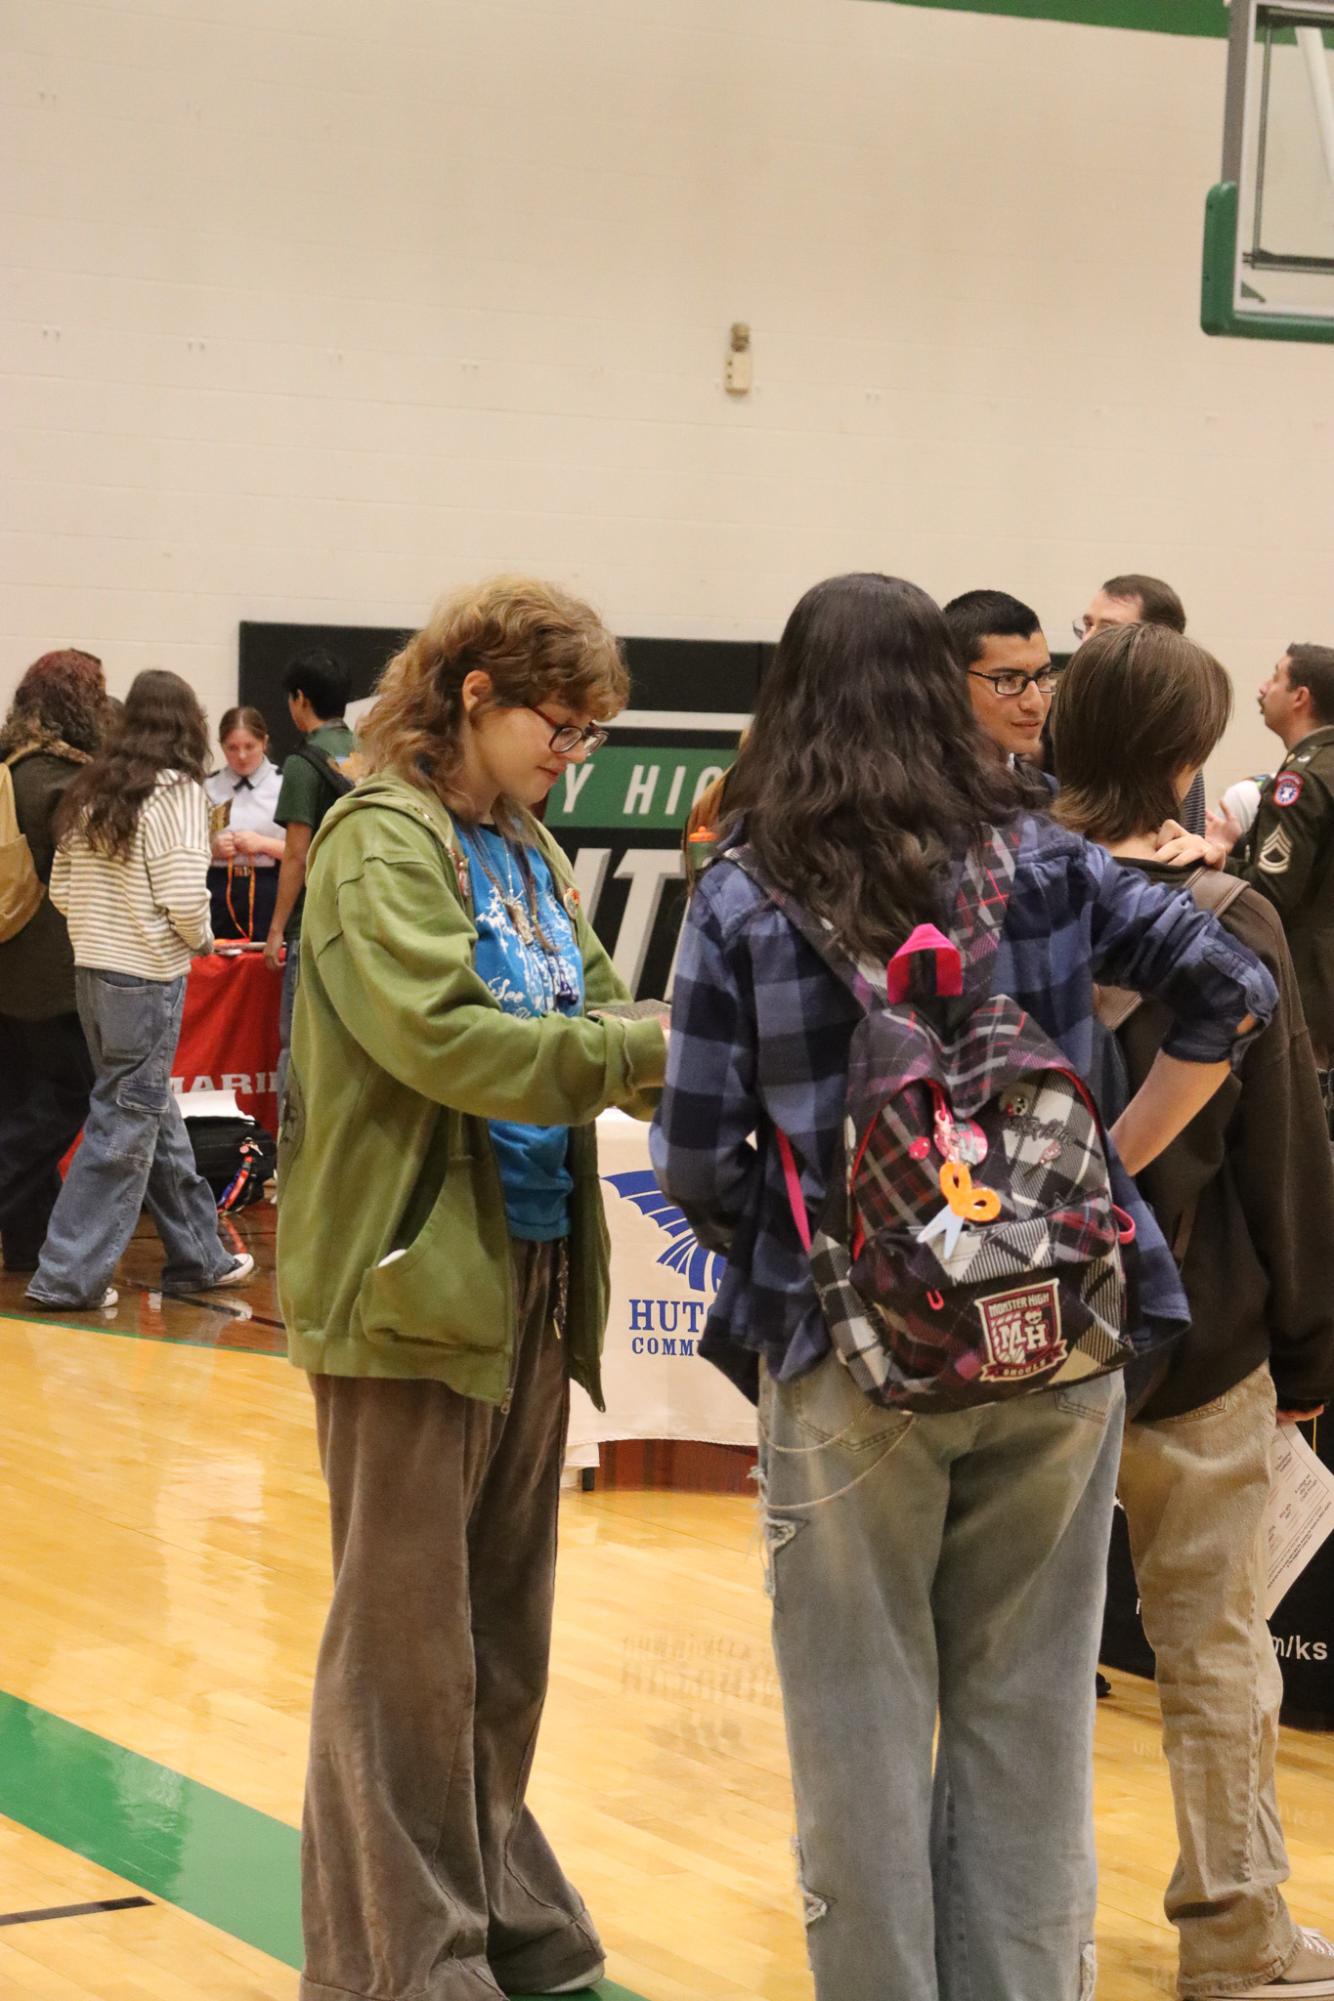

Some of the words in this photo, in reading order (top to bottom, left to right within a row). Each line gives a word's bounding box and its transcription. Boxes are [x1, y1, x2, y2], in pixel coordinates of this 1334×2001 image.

[563, 763, 594, 813] Y
[629, 1299, 704, 1333] HUT
[989, 1297, 1027, 1317] MONSTER
[1028, 1293, 1049, 1307] HIGH
[632, 1337, 698, 1356] COMM
[1272, 1635, 1328, 1660] m/ks
